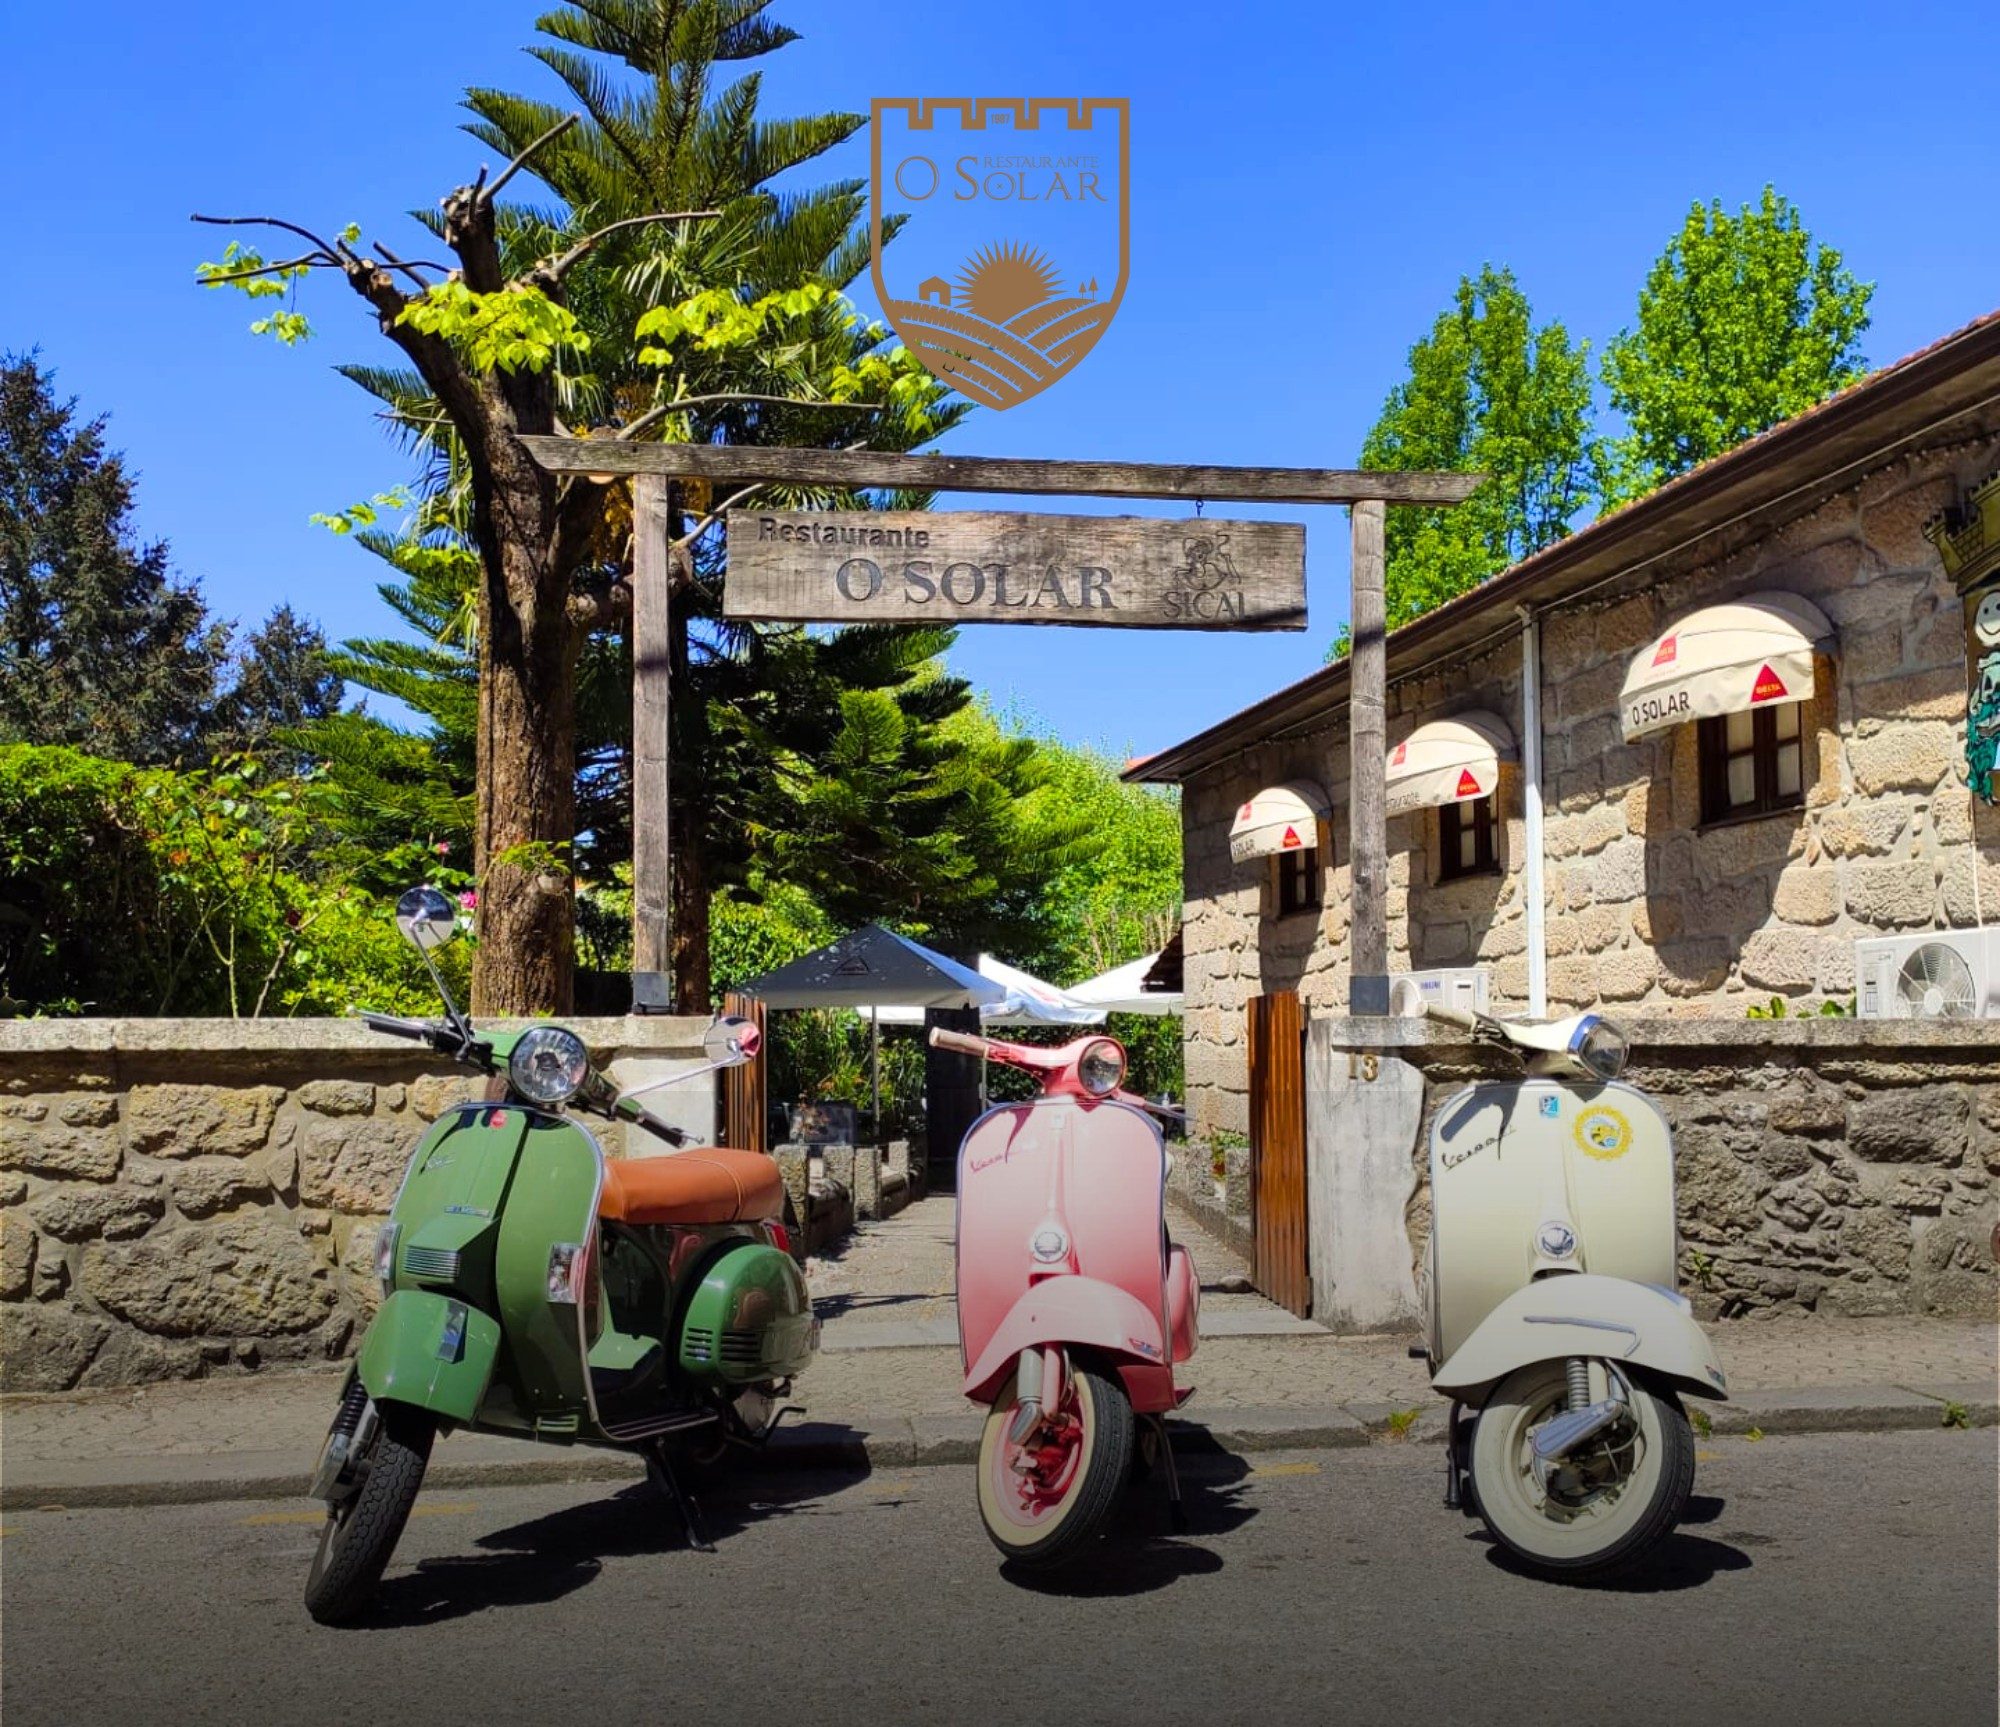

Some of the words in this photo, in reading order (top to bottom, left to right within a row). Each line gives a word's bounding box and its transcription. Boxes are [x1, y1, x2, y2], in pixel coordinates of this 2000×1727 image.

[759, 517, 930, 548] Restaurante
[836, 558, 883, 601] O
[903, 560, 1119, 609] SOLAR
[1632, 706, 1640, 725] O
[1642, 691, 1690, 722] SOLAR
